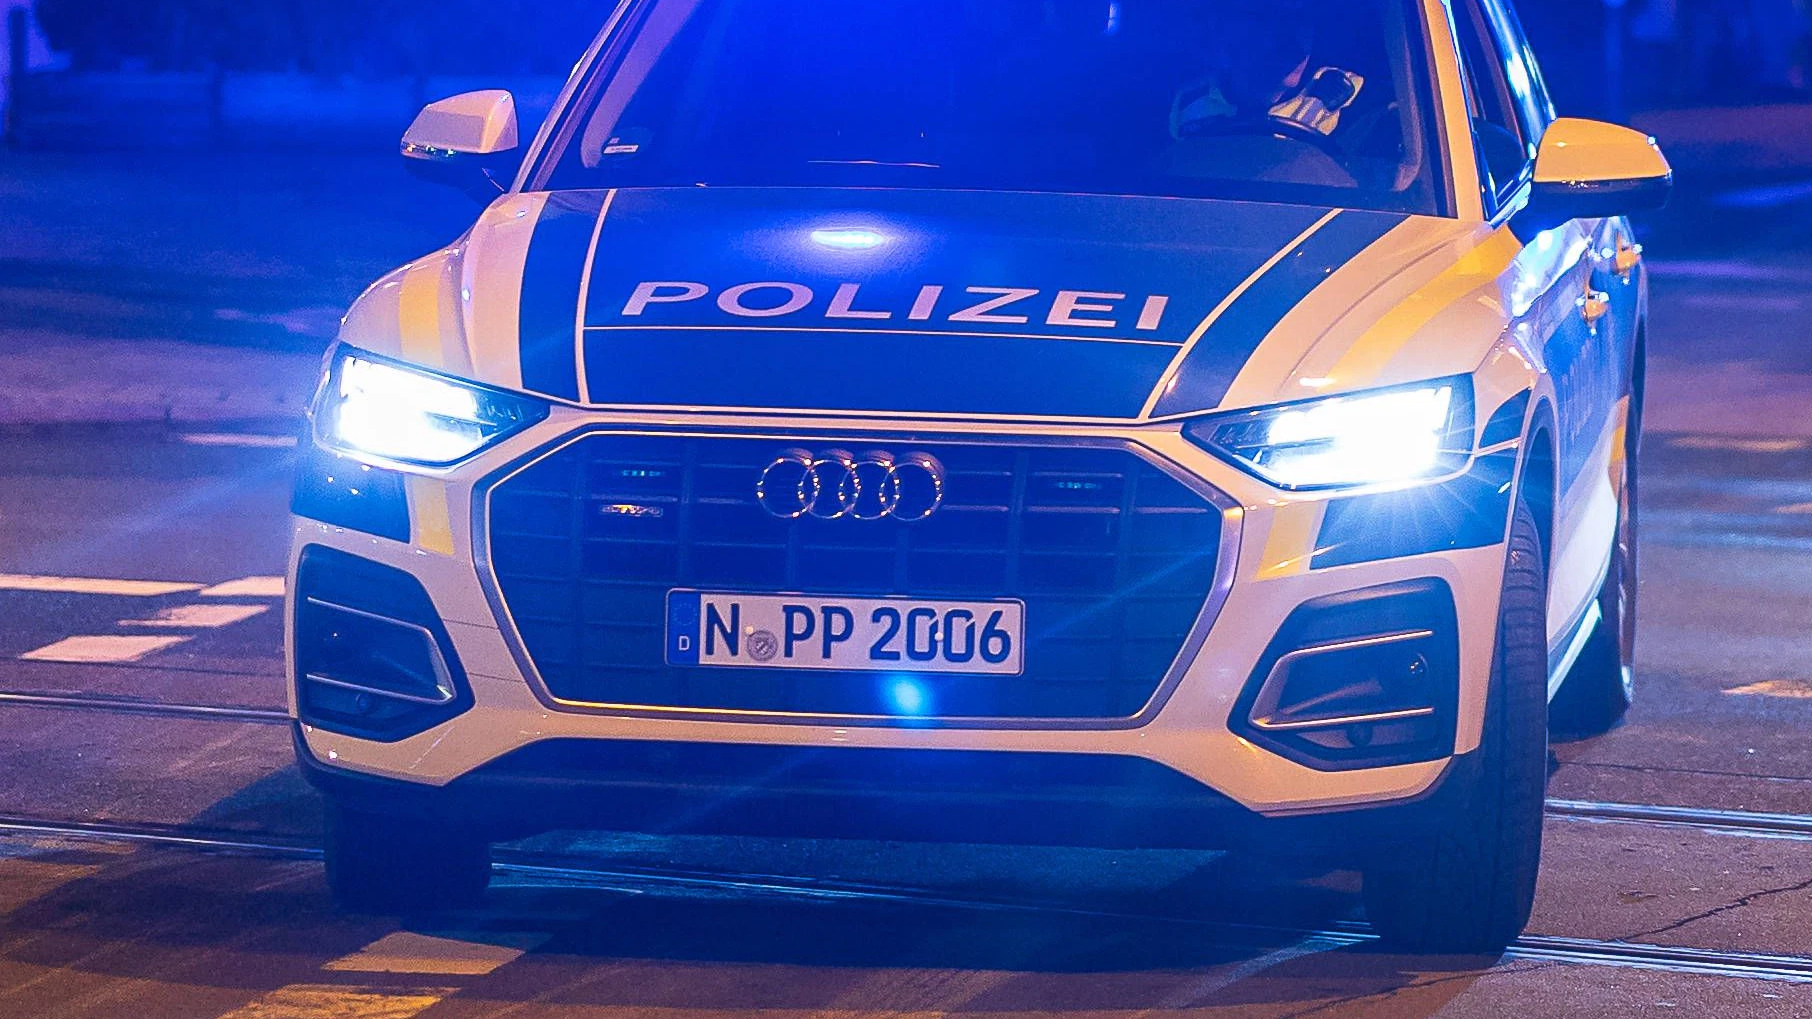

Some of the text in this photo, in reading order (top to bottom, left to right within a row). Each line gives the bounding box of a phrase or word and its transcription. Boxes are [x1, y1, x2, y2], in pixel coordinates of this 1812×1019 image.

[621, 281, 1169, 330] POLIZEI
[678, 635, 690, 651] D
[705, 602, 1012, 664] N PP 2006
